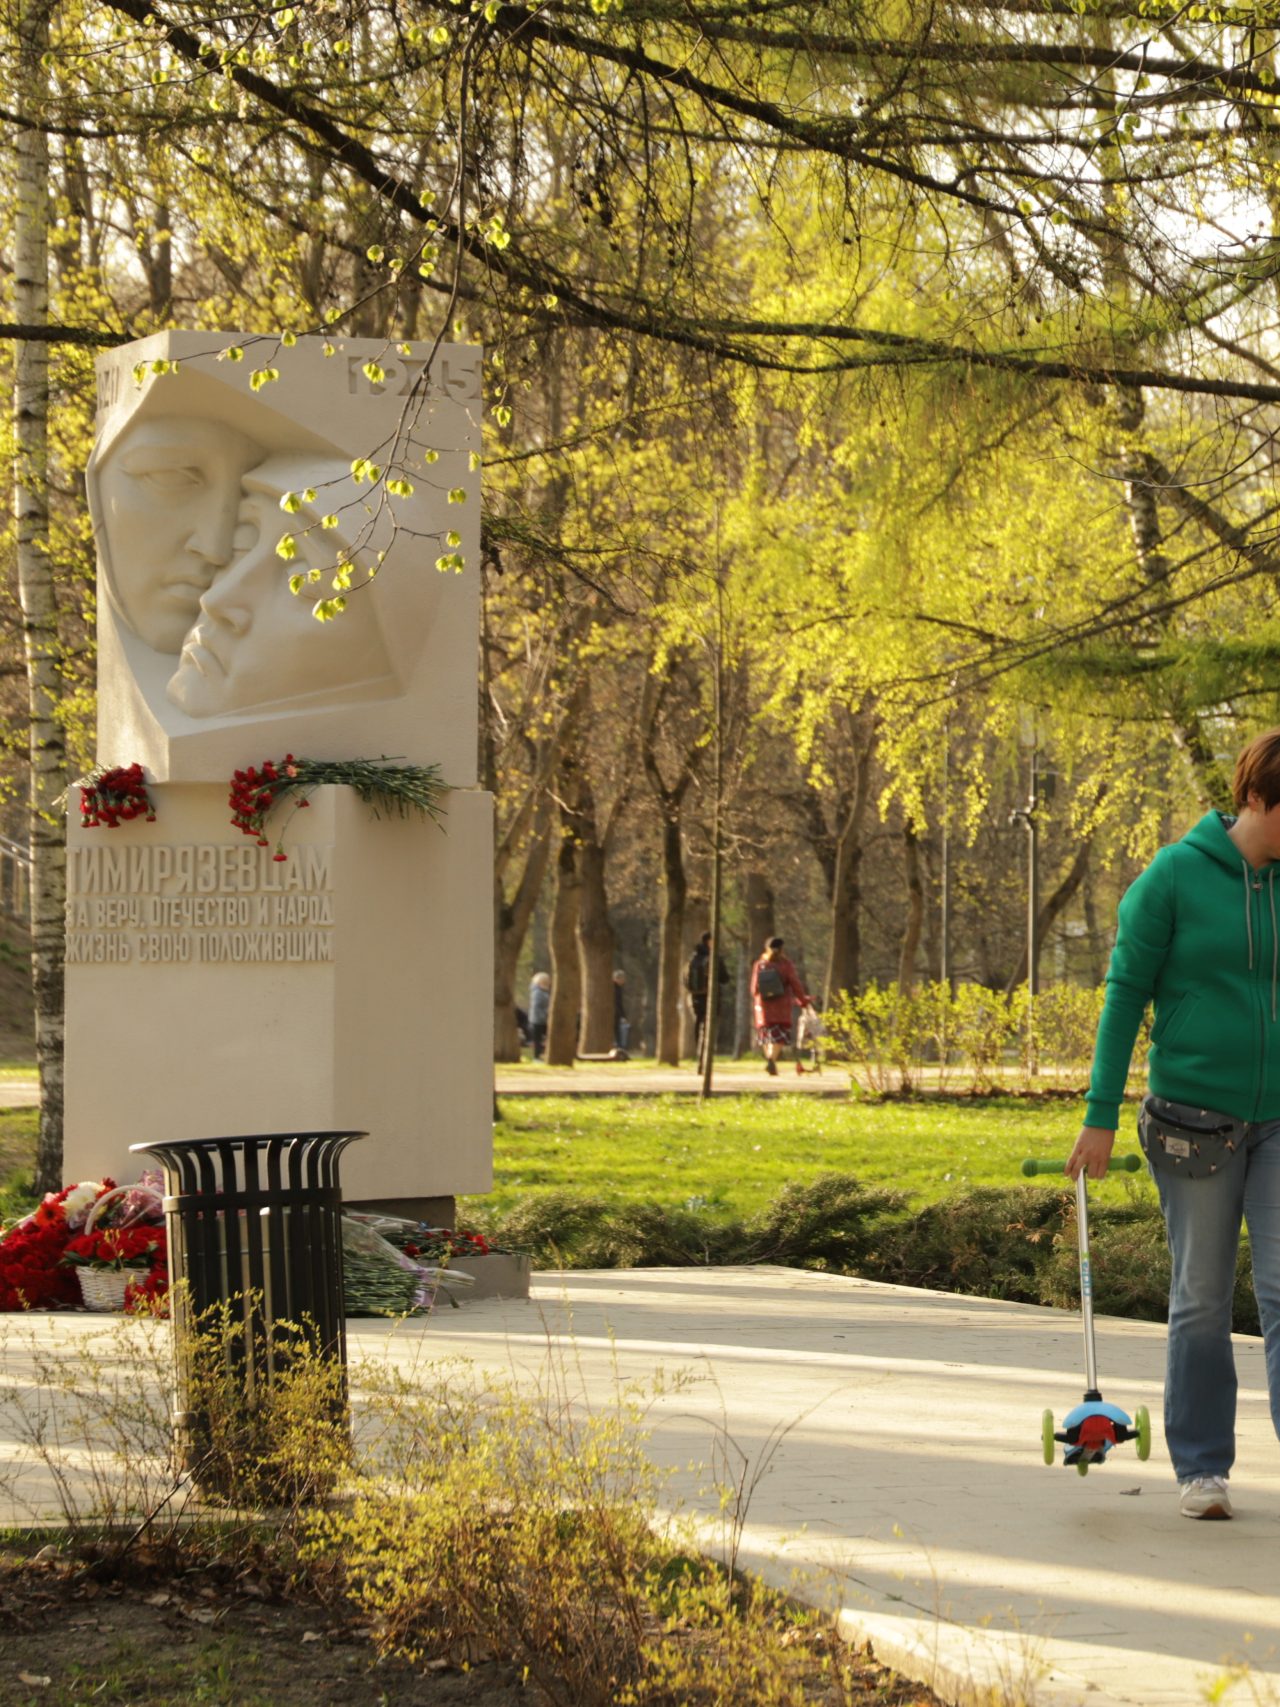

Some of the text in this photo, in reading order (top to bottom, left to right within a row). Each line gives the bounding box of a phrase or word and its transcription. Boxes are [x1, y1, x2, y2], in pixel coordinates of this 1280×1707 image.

[64, 845, 334, 892] ТИМИРЯЗЕВЦАМ
[64, 900, 90, 927] ЗА
[151, 897, 249, 926] ОТЕЧЕСТВО
[257, 897, 269, 924] И
[275, 896, 335, 925] НАРОД
[64, 933, 335, 961] ЖИЗНЬ СВОЮ ПОЛОЖИВШИМ
